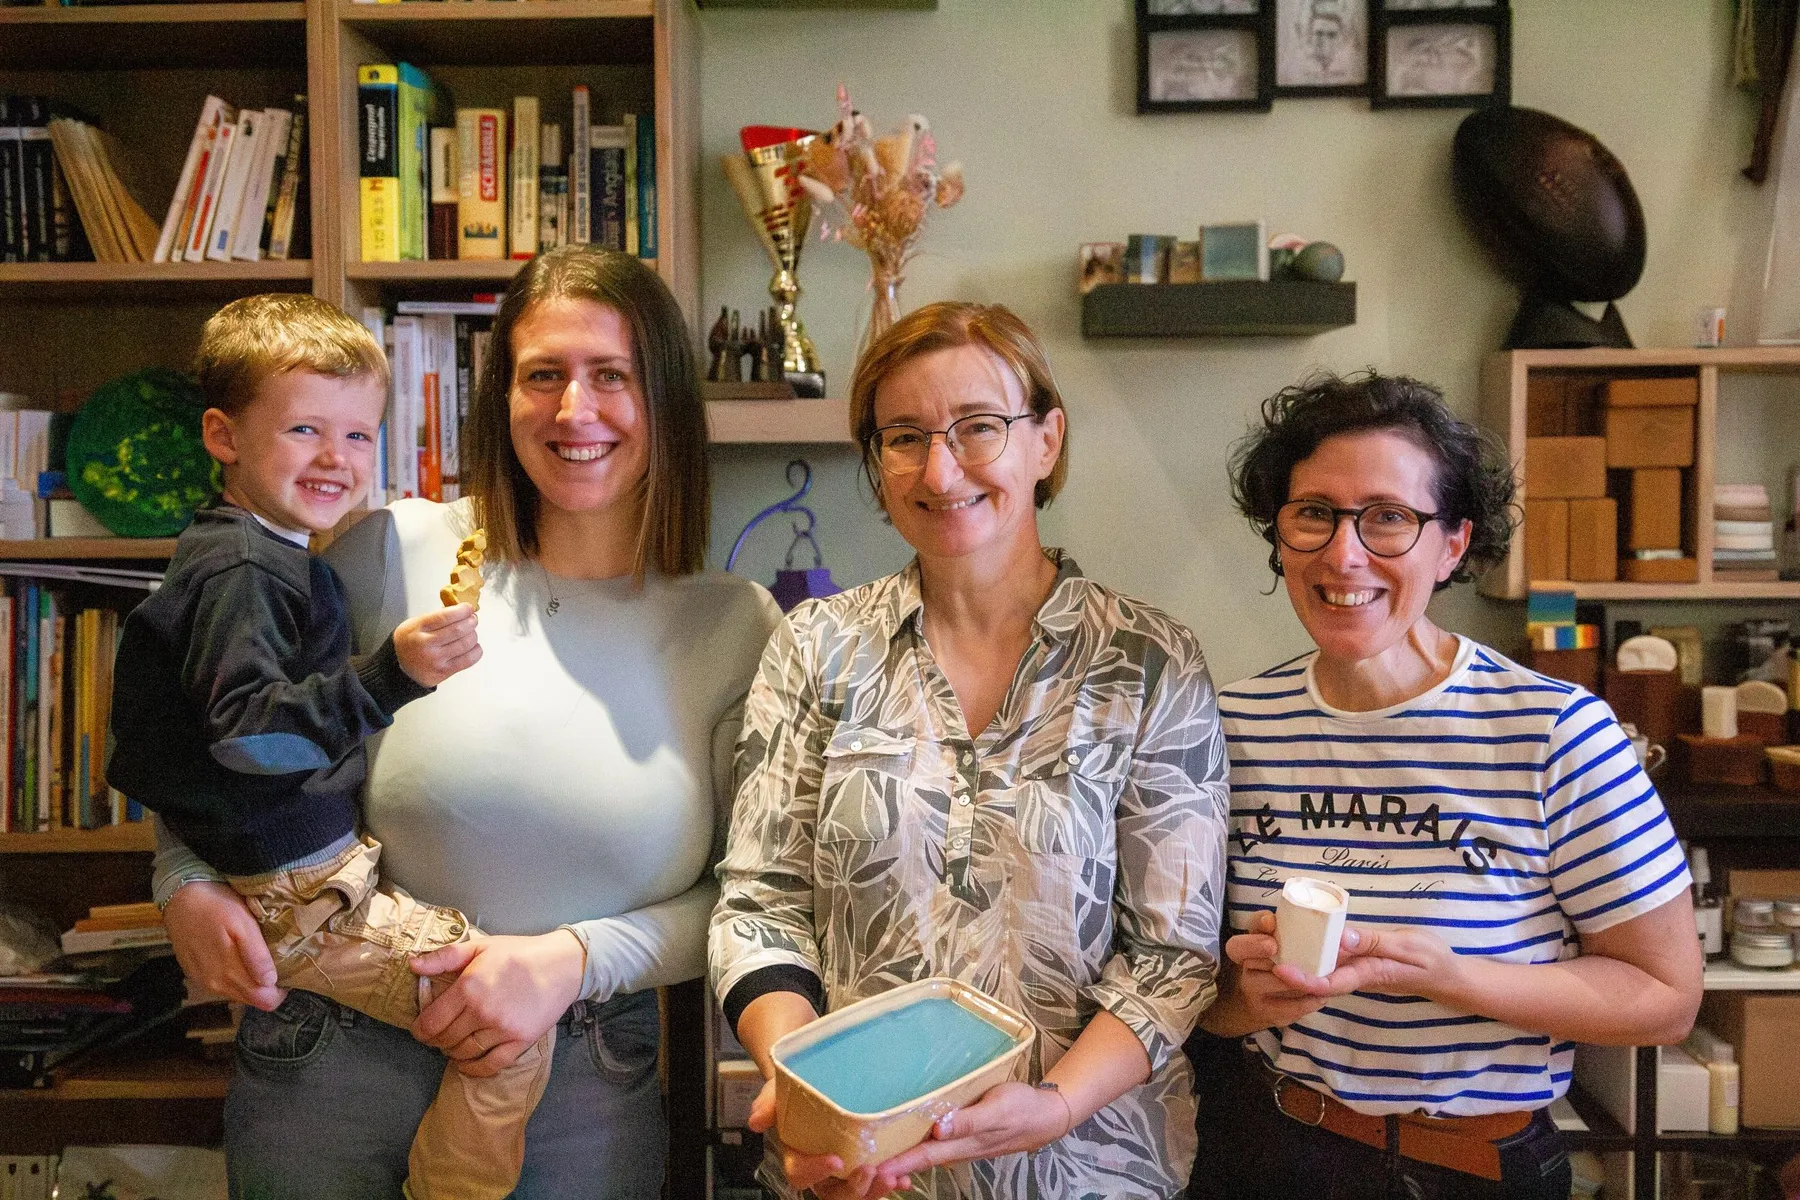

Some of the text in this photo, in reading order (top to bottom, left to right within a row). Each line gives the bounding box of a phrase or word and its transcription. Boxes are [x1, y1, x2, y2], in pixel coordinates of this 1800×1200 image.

[1235, 793, 1497, 876] LE MARAIS
[1315, 846, 1391, 870] Paris
